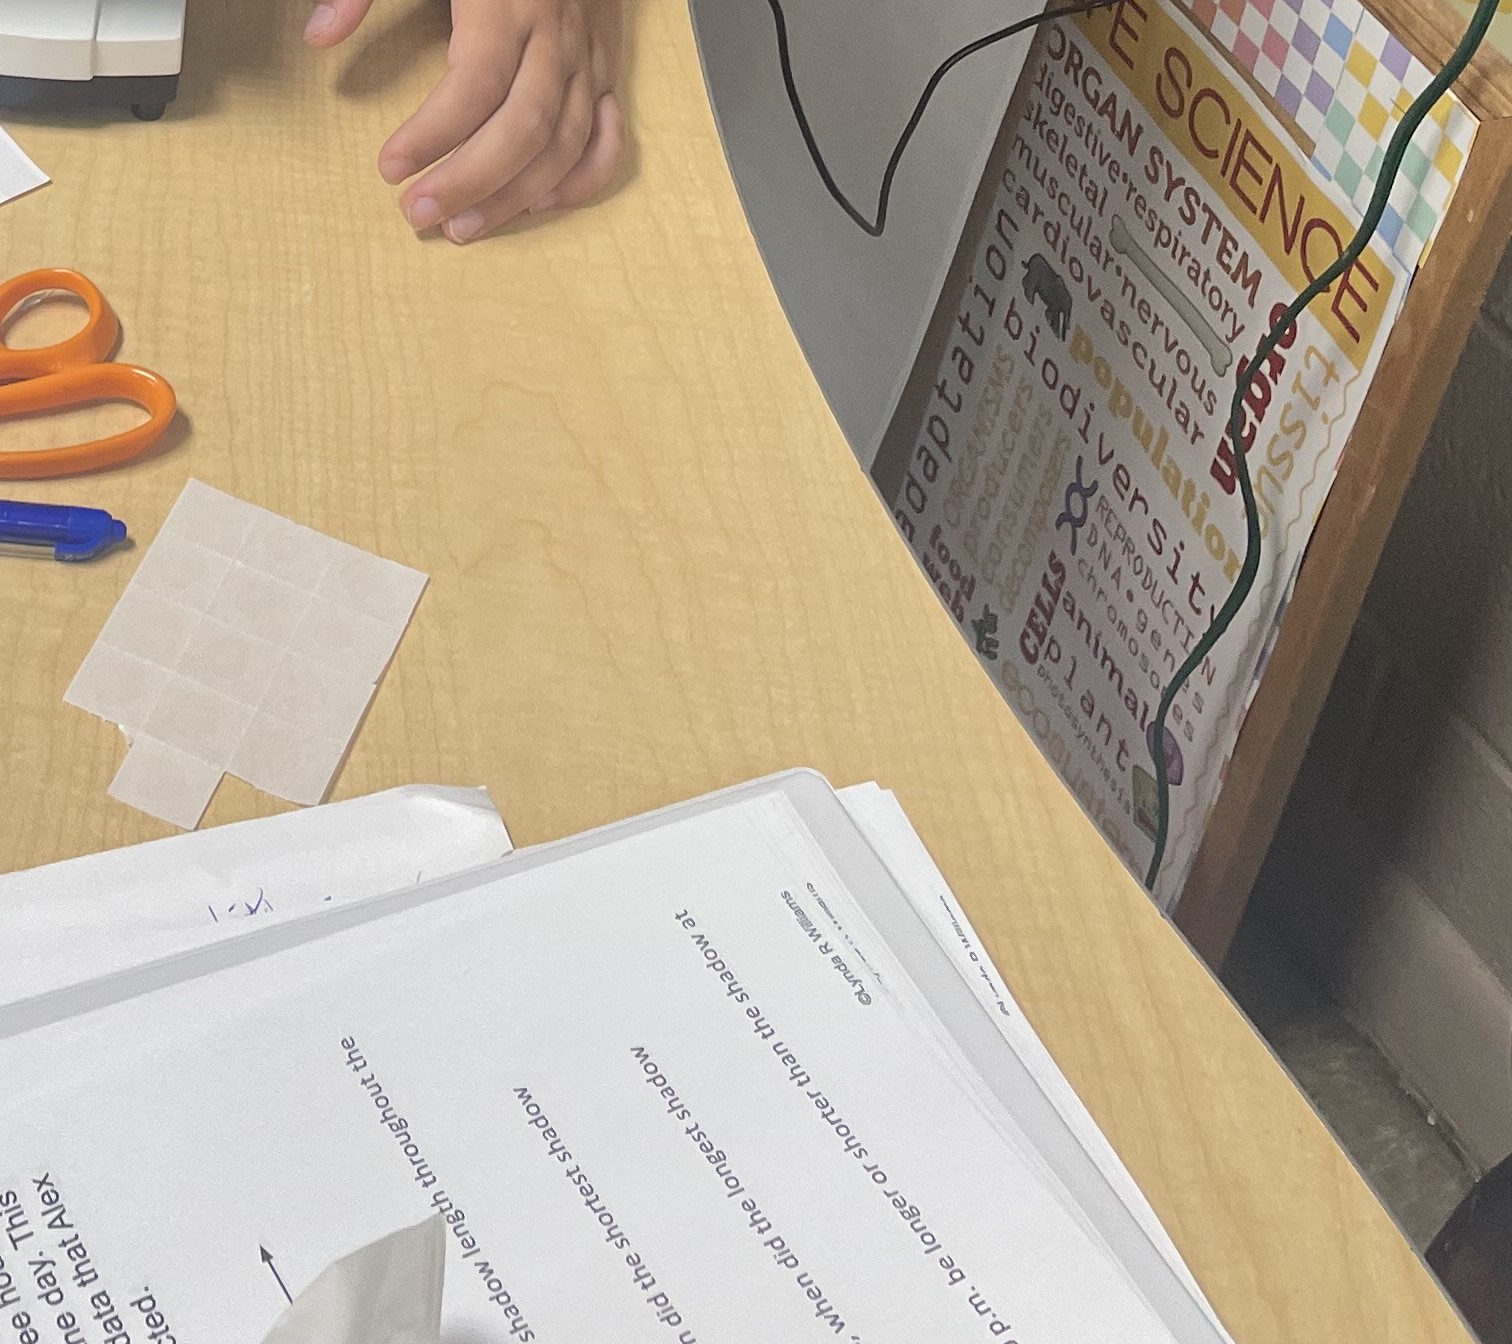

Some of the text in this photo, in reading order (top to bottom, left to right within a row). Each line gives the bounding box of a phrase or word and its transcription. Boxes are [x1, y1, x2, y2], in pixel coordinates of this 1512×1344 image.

[1048, 26, 1262, 307] ORGAN SYSTEM
[1003, 168, 1206, 445] cardiovascular
[1018, 550, 1067, 665] CELLS
[1045, 635, 1129, 773] plant
[1063, 590, 1151, 732] animal
[32, 1171, 99, 1288] that Alex
[340, 1035, 541, 1344] shadow length throughout the
[630, 1046, 846, 1335] when did the longest shadow
[674, 908, 1012, 1344] p.m. be longer or shorter than the shadow at
